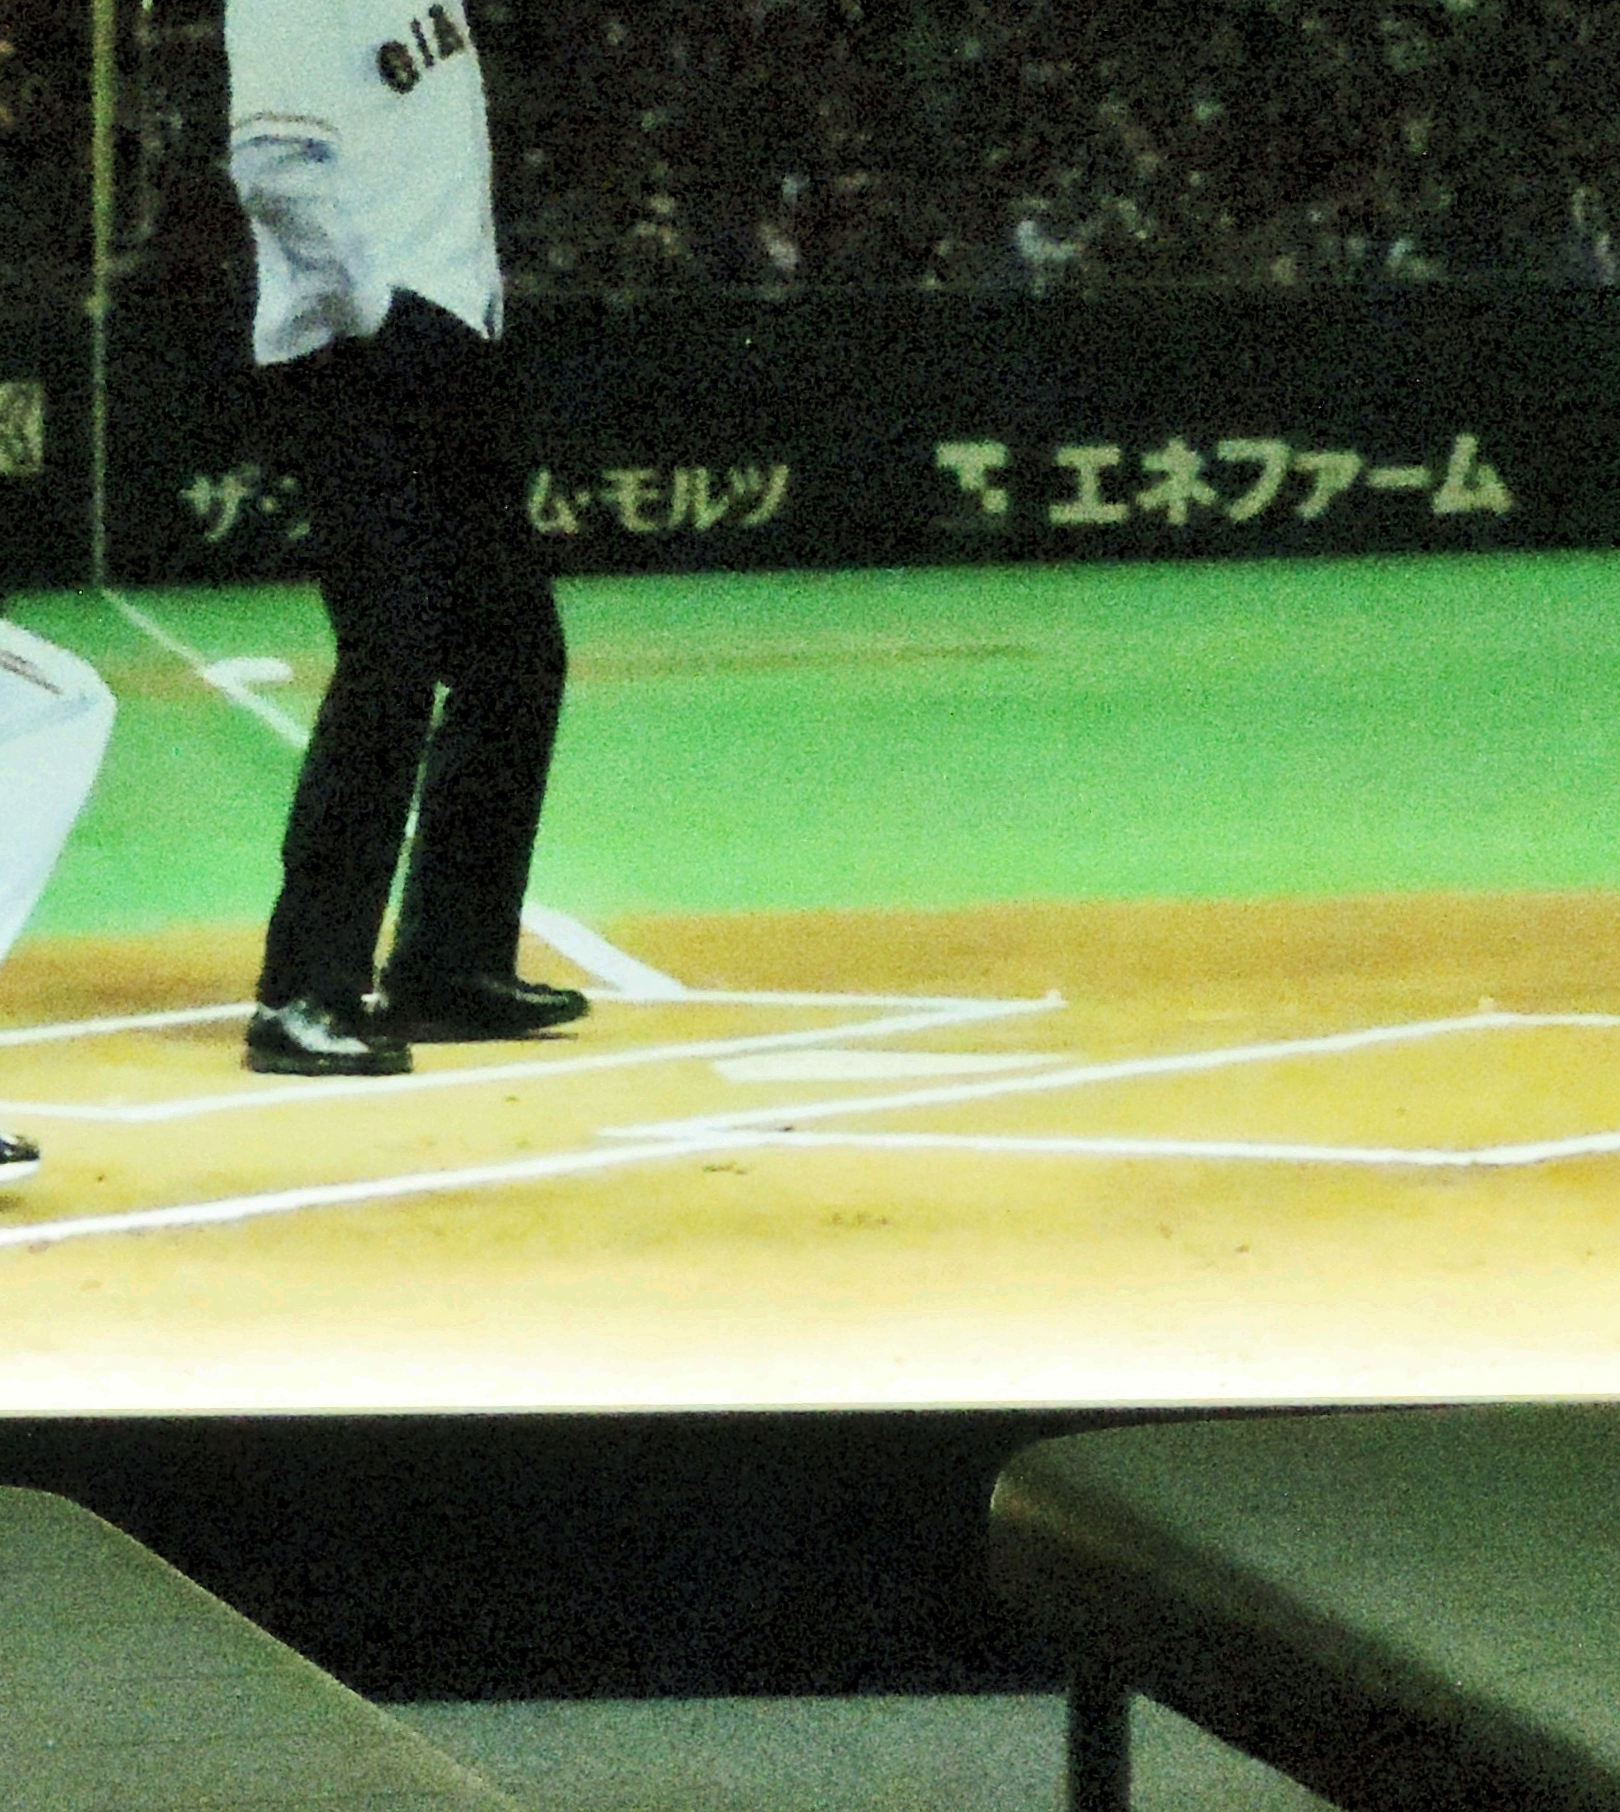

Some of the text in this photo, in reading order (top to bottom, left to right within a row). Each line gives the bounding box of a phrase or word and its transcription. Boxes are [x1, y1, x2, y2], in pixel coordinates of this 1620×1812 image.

[1049, 431, 1513, 526] エネファーム
